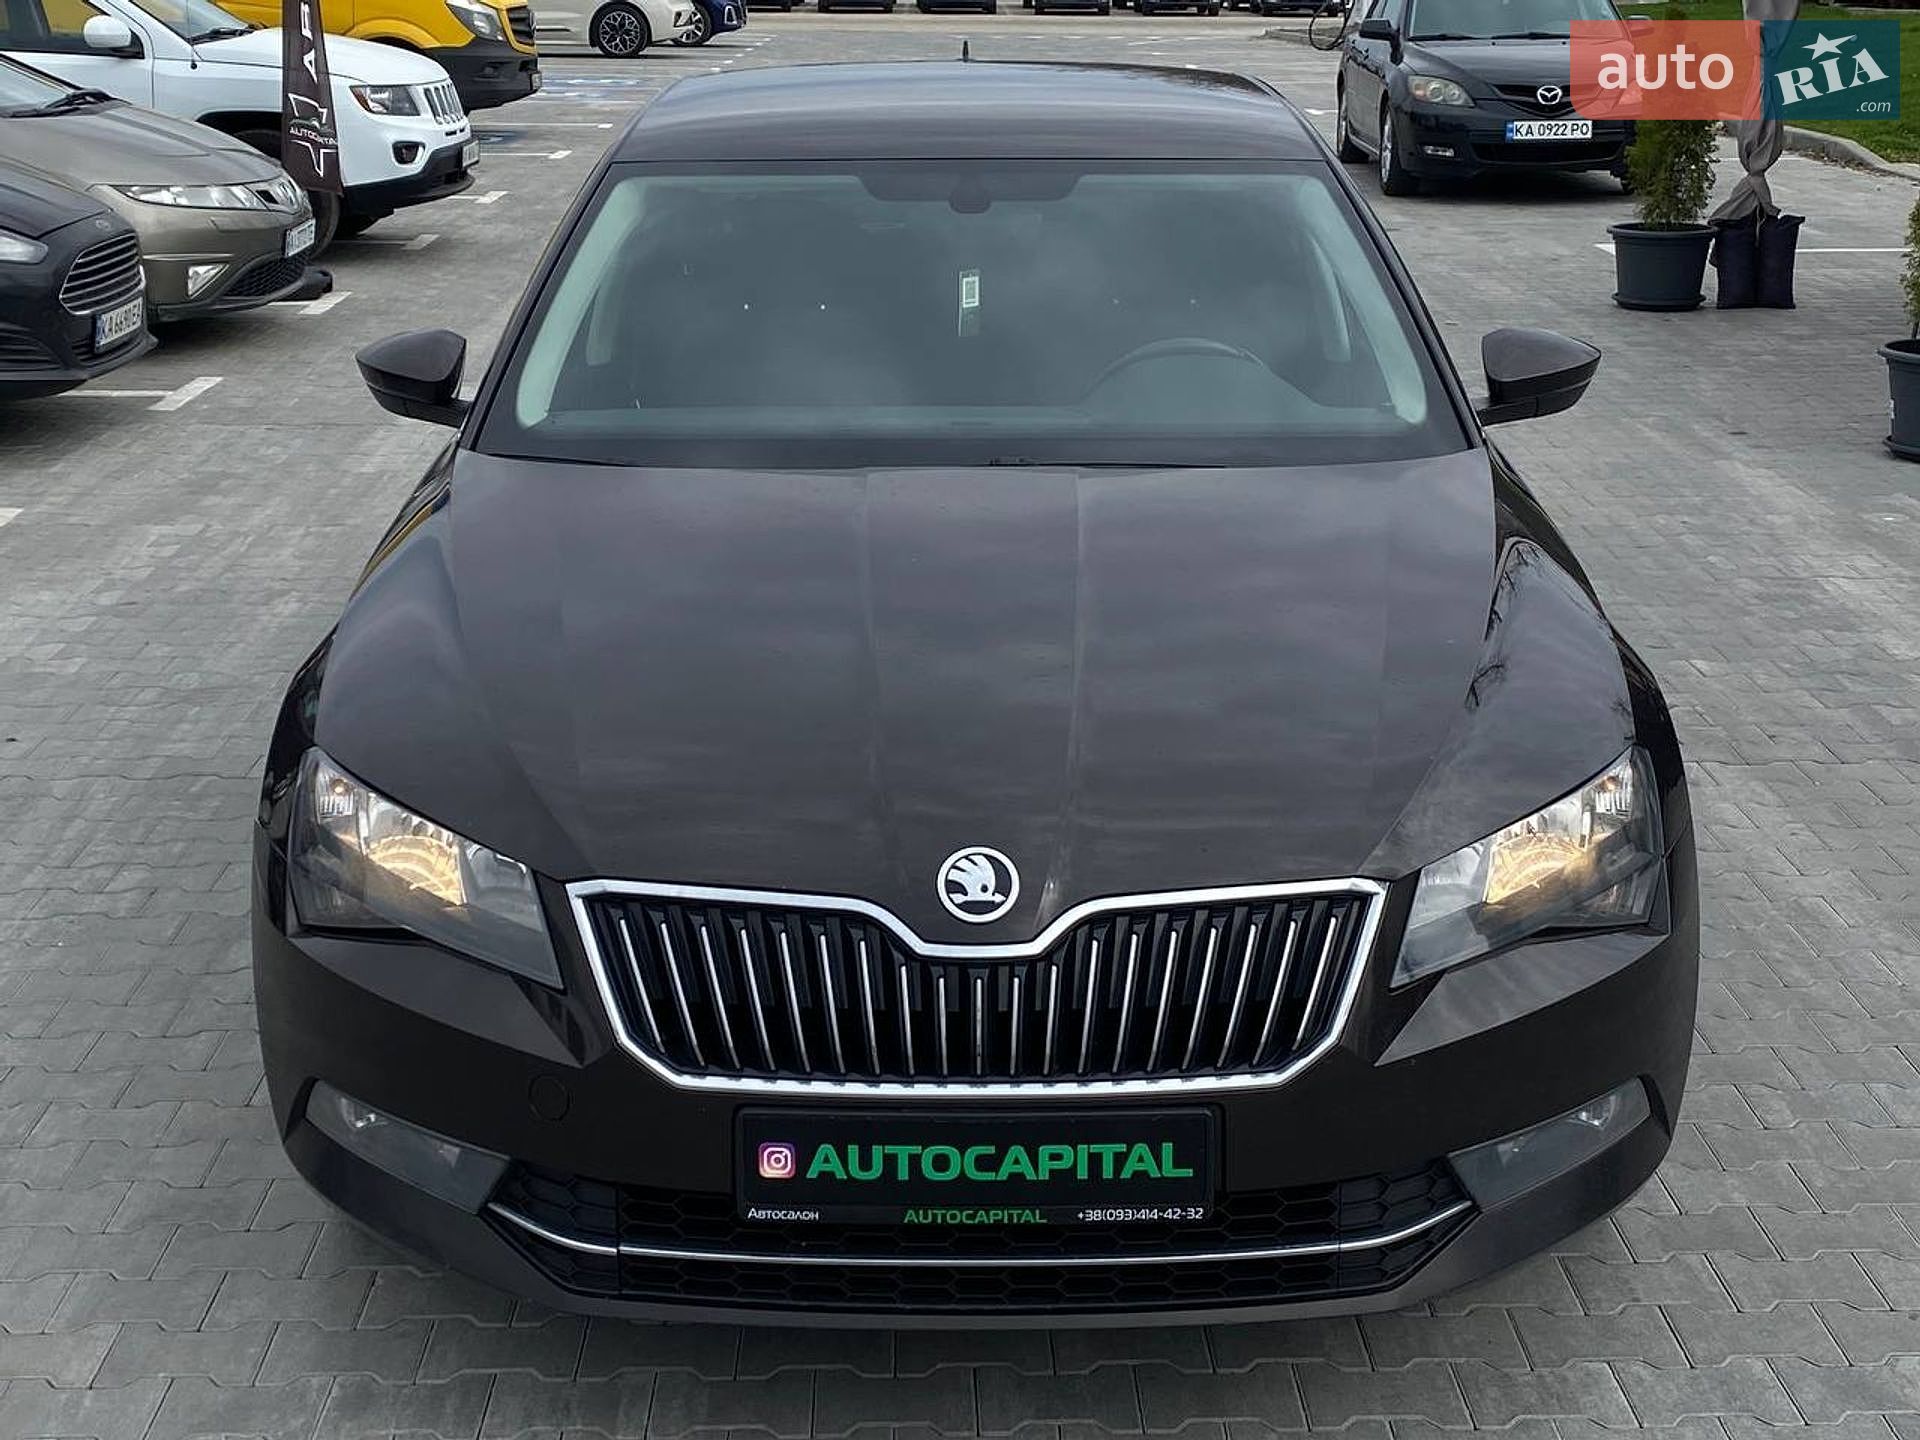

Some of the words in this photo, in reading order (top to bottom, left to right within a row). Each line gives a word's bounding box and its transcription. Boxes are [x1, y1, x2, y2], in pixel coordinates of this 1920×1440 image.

[1515, 123, 1534, 137] KA
[1537, 123, 1568, 137] 0922
[1571, 123, 1590, 136] PO
[805, 1142, 1194, 1181] AUTOCAPITAL
[903, 1208, 1048, 1224] AUTOCAPITAL
[1077, 1207, 1204, 1221] +38(093)414-42-32
